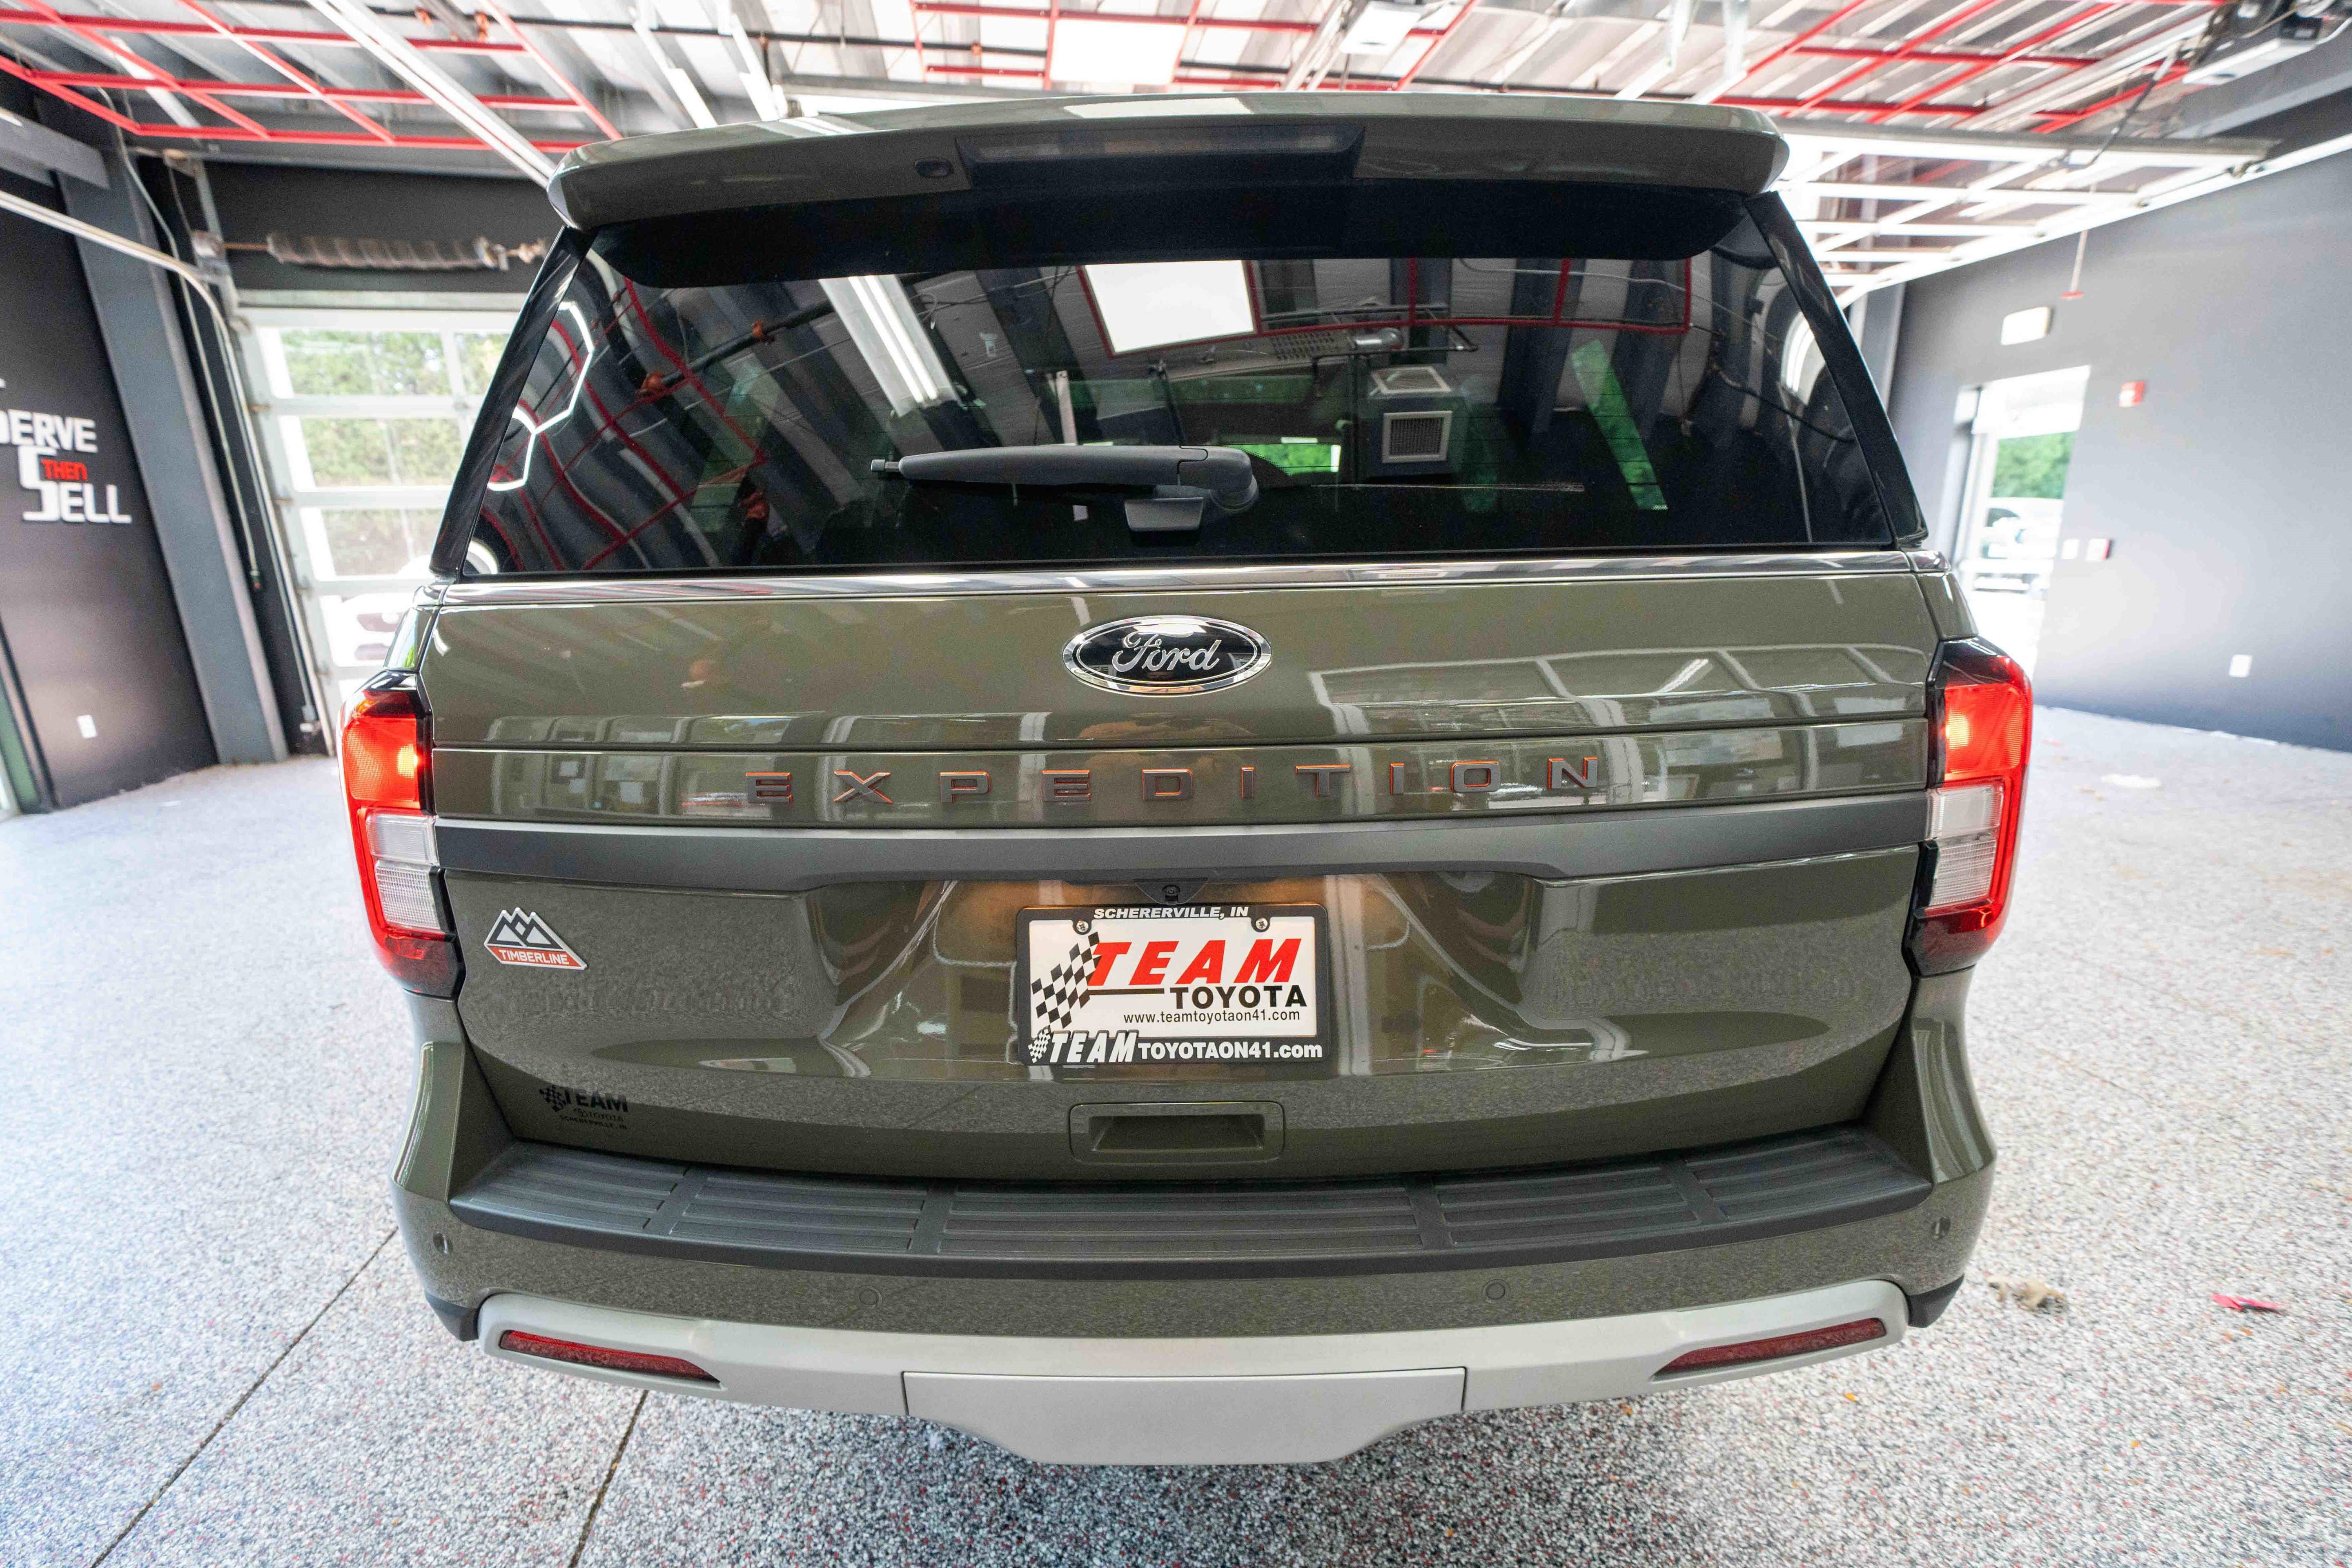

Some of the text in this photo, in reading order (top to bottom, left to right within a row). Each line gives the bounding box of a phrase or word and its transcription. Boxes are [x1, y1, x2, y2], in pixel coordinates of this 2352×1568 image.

[41, 459, 88, 481] THEN
[18, 445, 132, 523] SELL
[1112, 631, 1221, 672] Ford
[746, 757, 1598, 804] EXPEDITION
[1094, 906, 1249, 919] SCHERERVILLE, IN
[498, 949, 570, 965] TIMBERLINE
[1087, 938, 1301, 986] TEAM
[1170, 985, 1307, 1009] TOYOTA
[1124, 1010, 1300, 1025] www.teamtoyotaon41.com
[563, 1089, 629, 1112] TEAM
